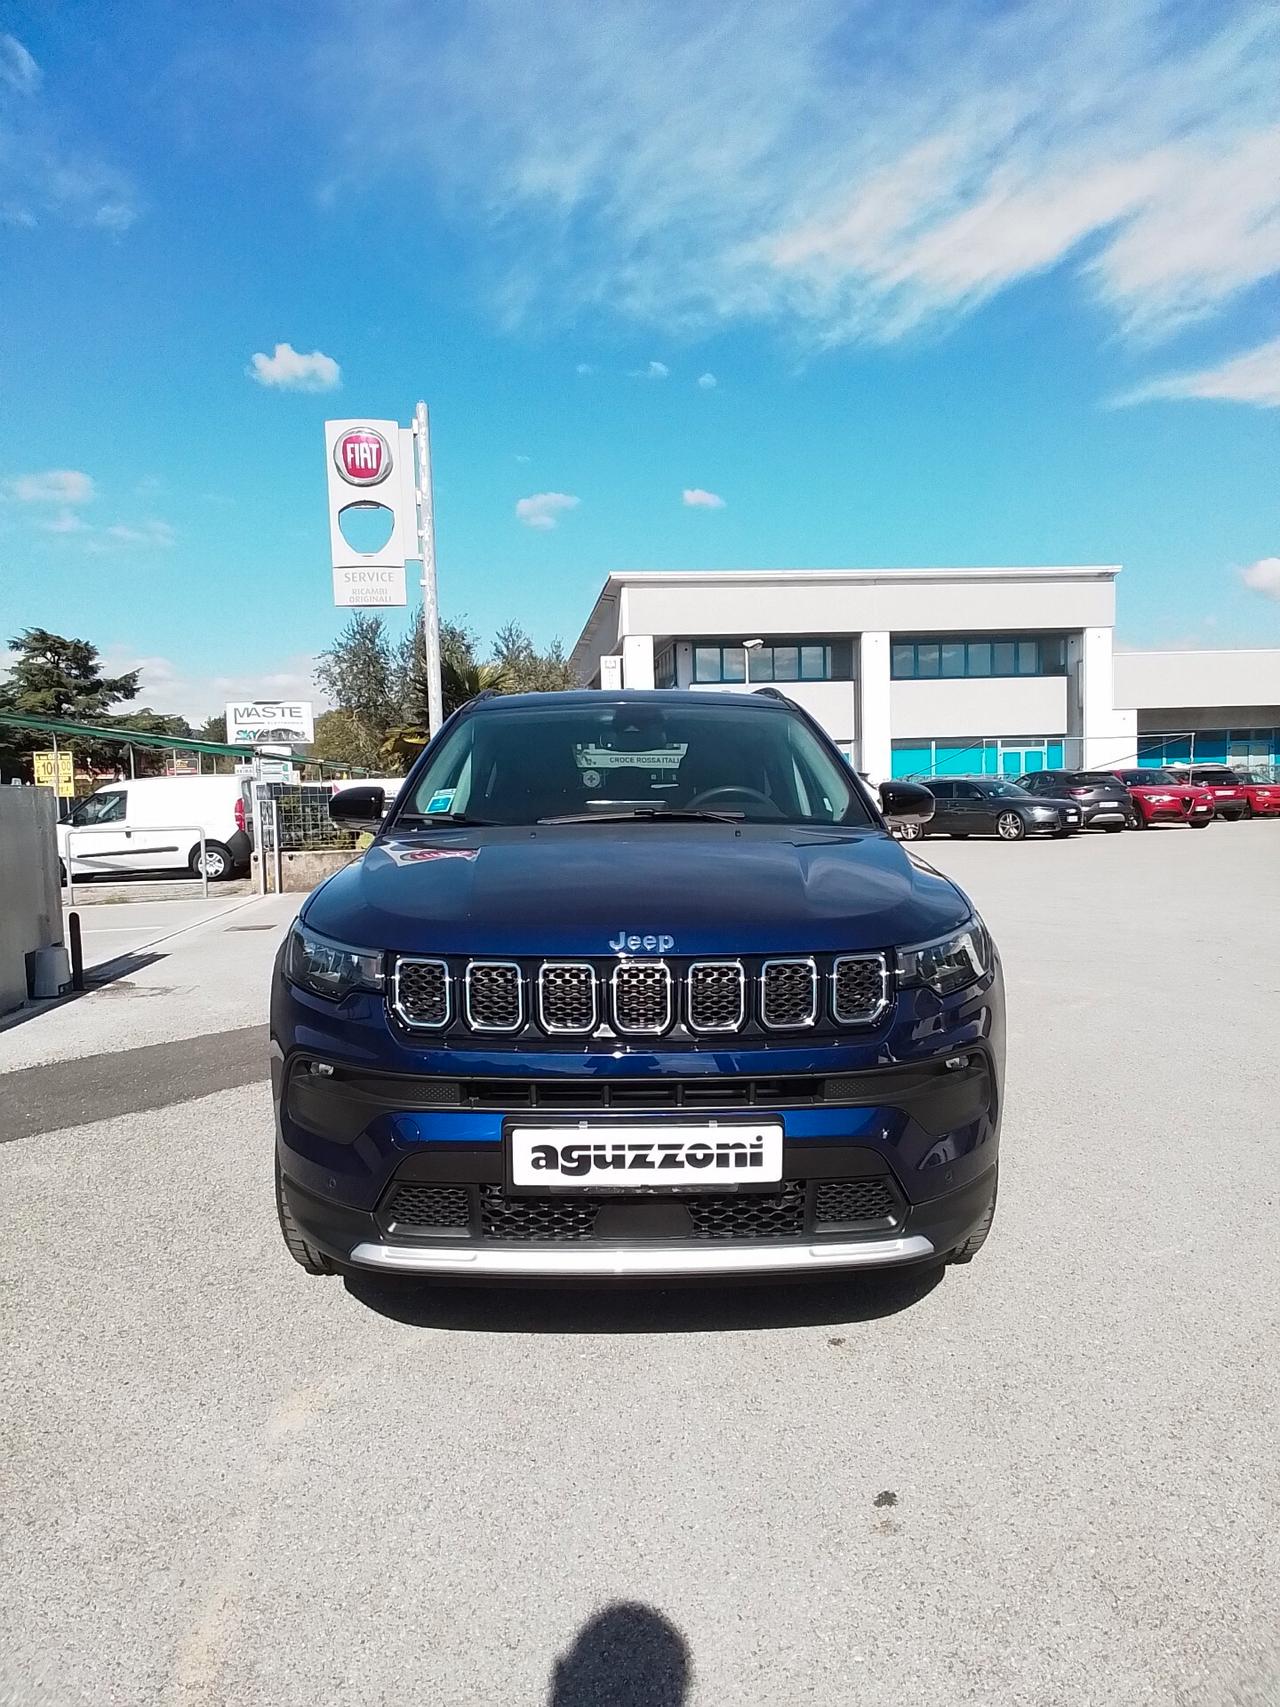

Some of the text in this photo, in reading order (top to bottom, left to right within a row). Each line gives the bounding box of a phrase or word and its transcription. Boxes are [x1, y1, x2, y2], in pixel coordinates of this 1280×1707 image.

[347, 441, 379, 470] FIAT
[344, 571, 394, 583] SERVICE
[609, 931, 675, 953] Jeep
[531, 1135, 763, 1176] aguzzoni
